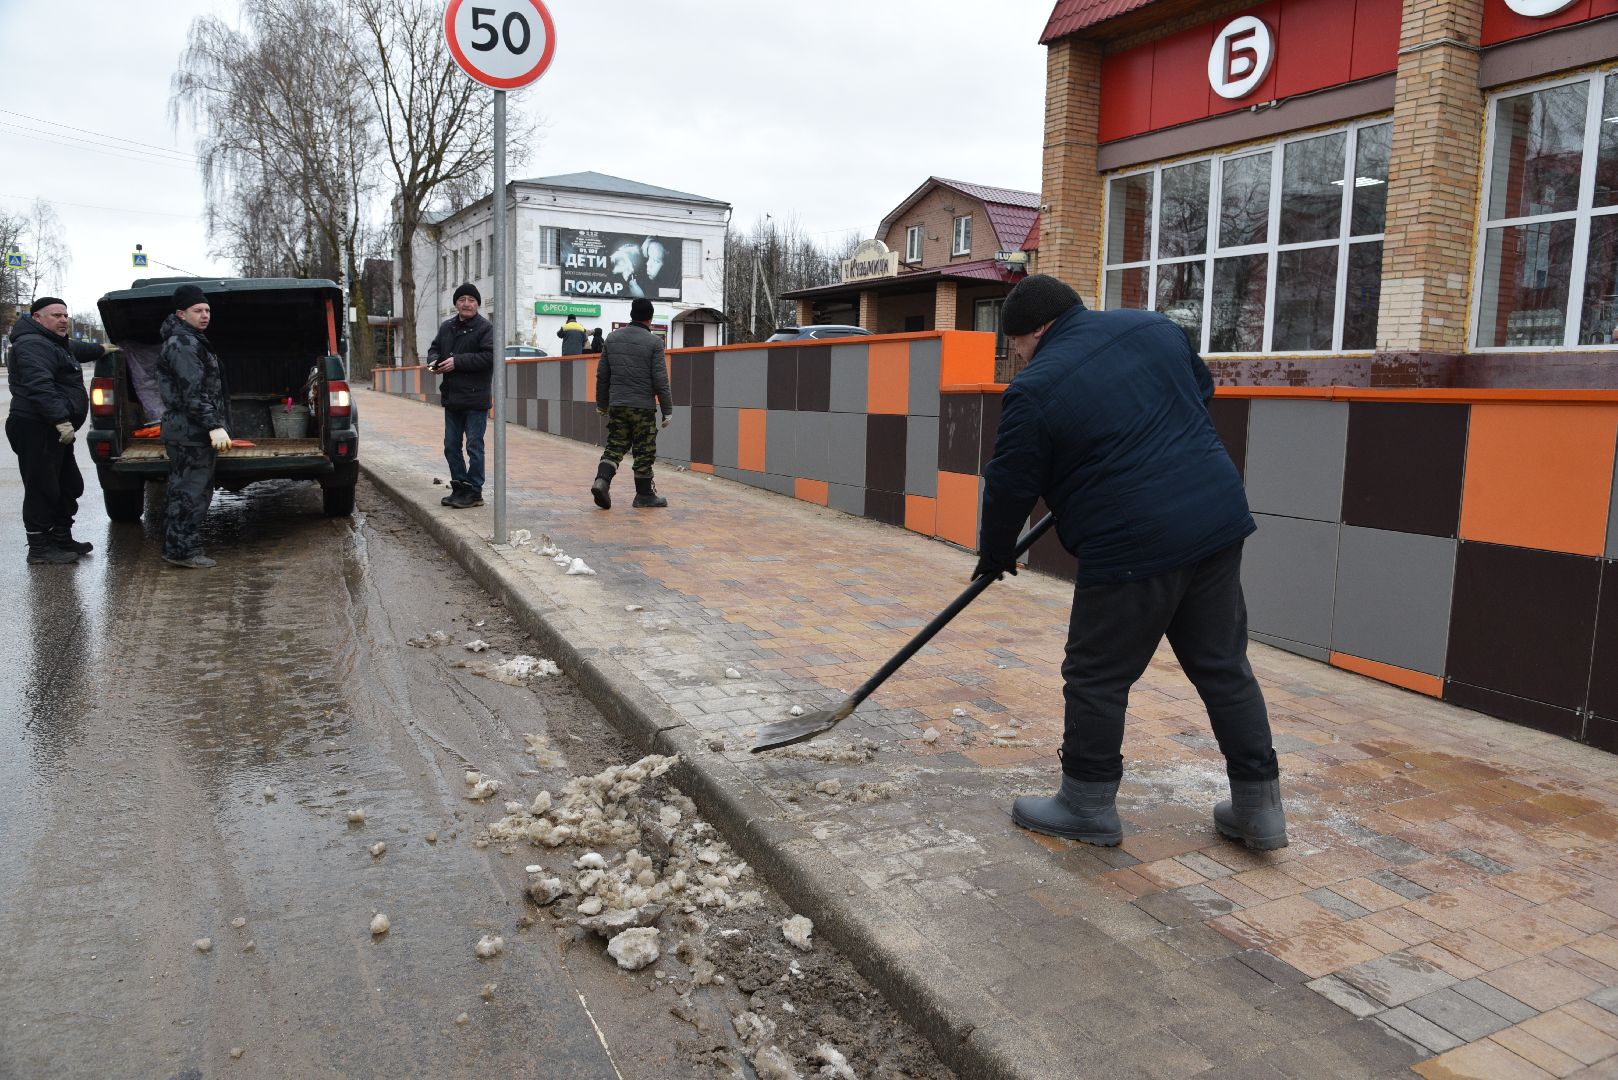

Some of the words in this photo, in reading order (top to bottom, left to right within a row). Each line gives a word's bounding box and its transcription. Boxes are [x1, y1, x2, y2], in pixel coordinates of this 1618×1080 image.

[471, 6, 531, 55] 50
[1222, 27, 1257, 85] Б
[565, 253, 607, 269] ДЕТИ
[564, 279, 624, 295] ПОЖАР
[549, 304, 568, 312] РЕСО
